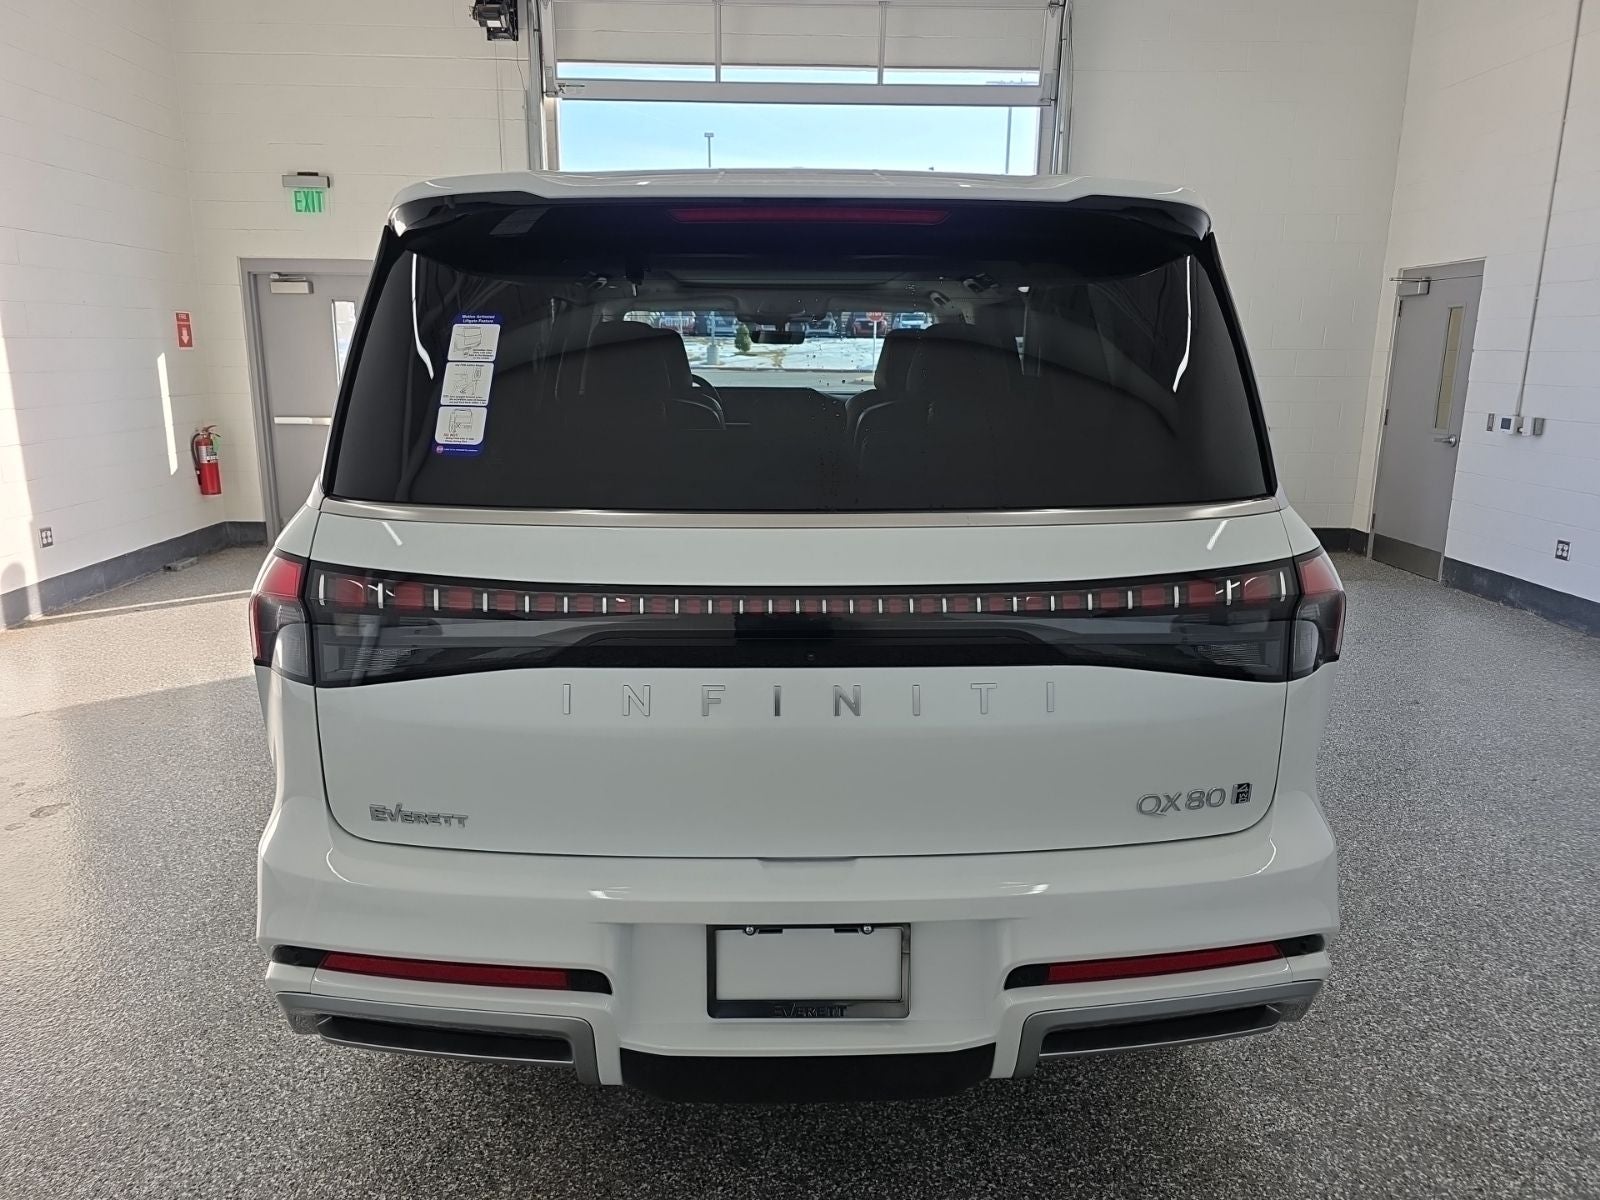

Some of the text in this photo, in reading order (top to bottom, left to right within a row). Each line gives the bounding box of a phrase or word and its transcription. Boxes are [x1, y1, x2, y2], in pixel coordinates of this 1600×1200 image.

[294, 190, 323, 213] EXIT
[562, 681, 1055, 717] INFINITI
[1136, 787, 1227, 816] QX80
